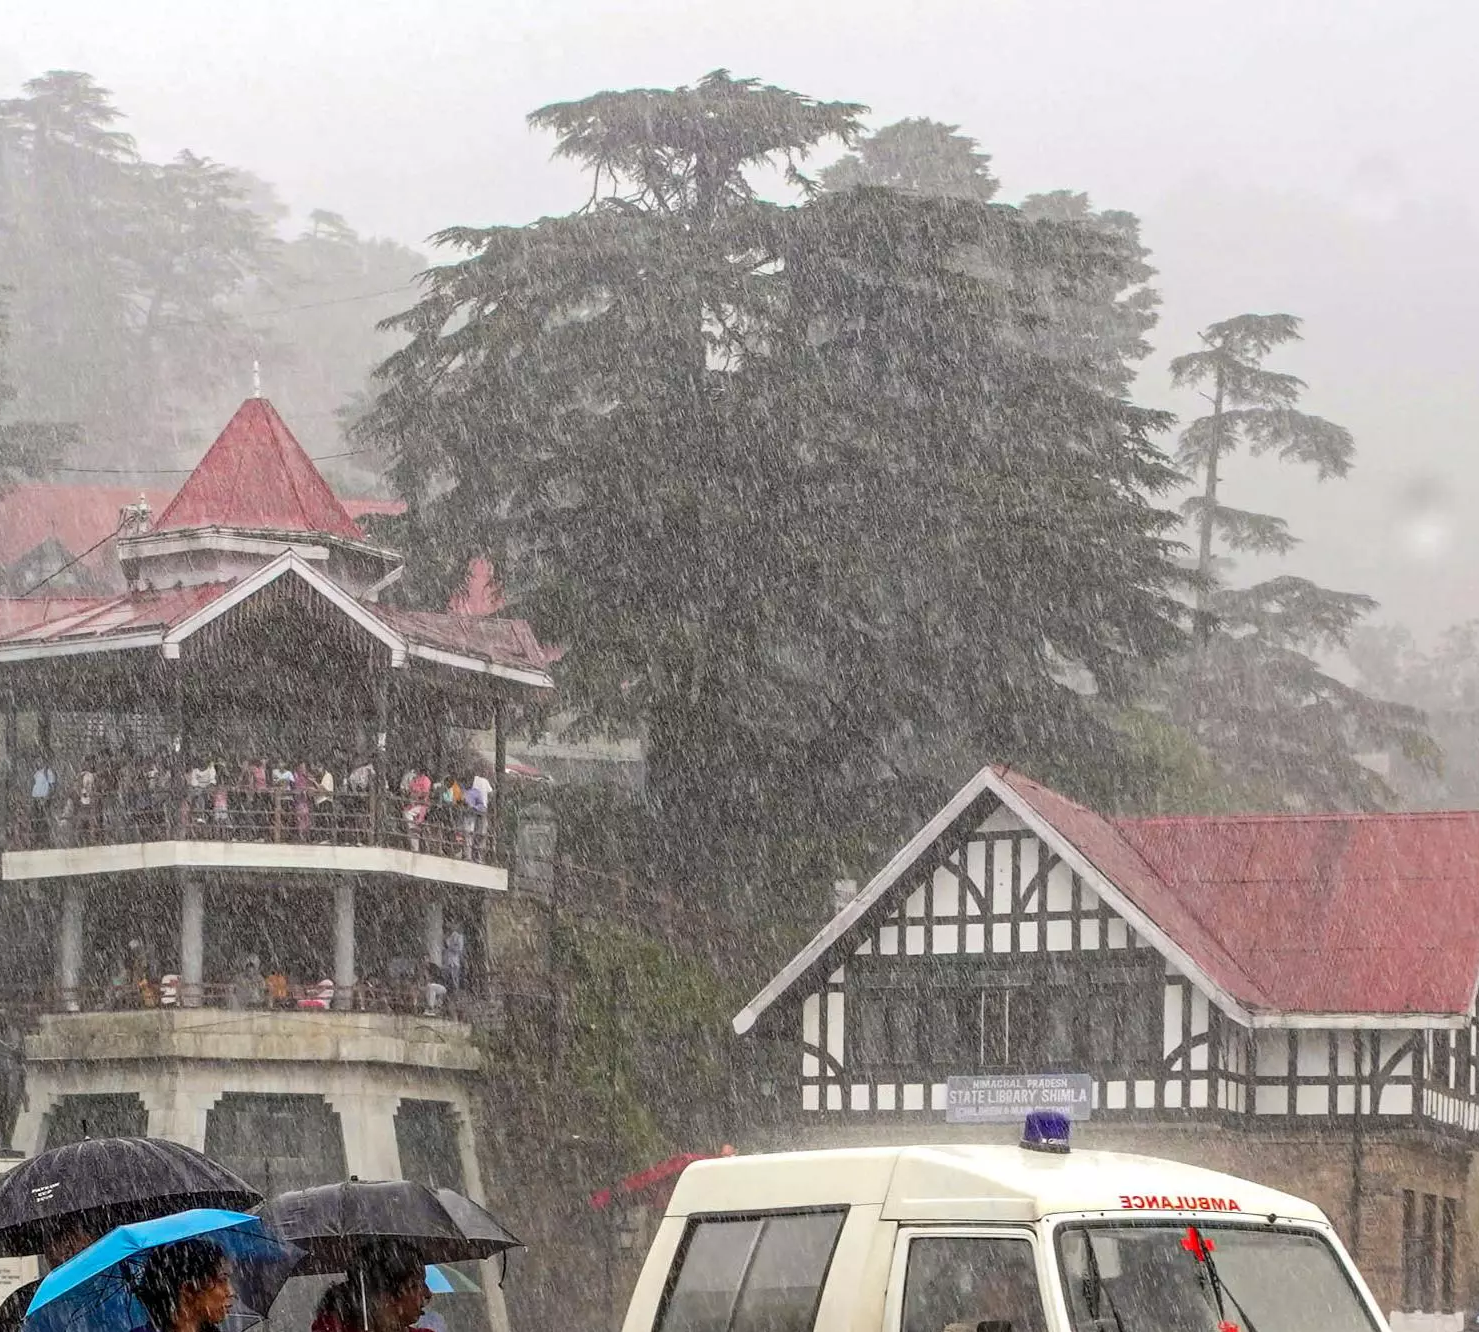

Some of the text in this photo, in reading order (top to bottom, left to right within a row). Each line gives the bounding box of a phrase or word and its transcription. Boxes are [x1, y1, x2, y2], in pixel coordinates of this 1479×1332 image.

[972, 1078, 1068, 1089] HIMACHAL PRADESH
[949, 1088, 1087, 1104] STATE LIBRARY SHIMLA
